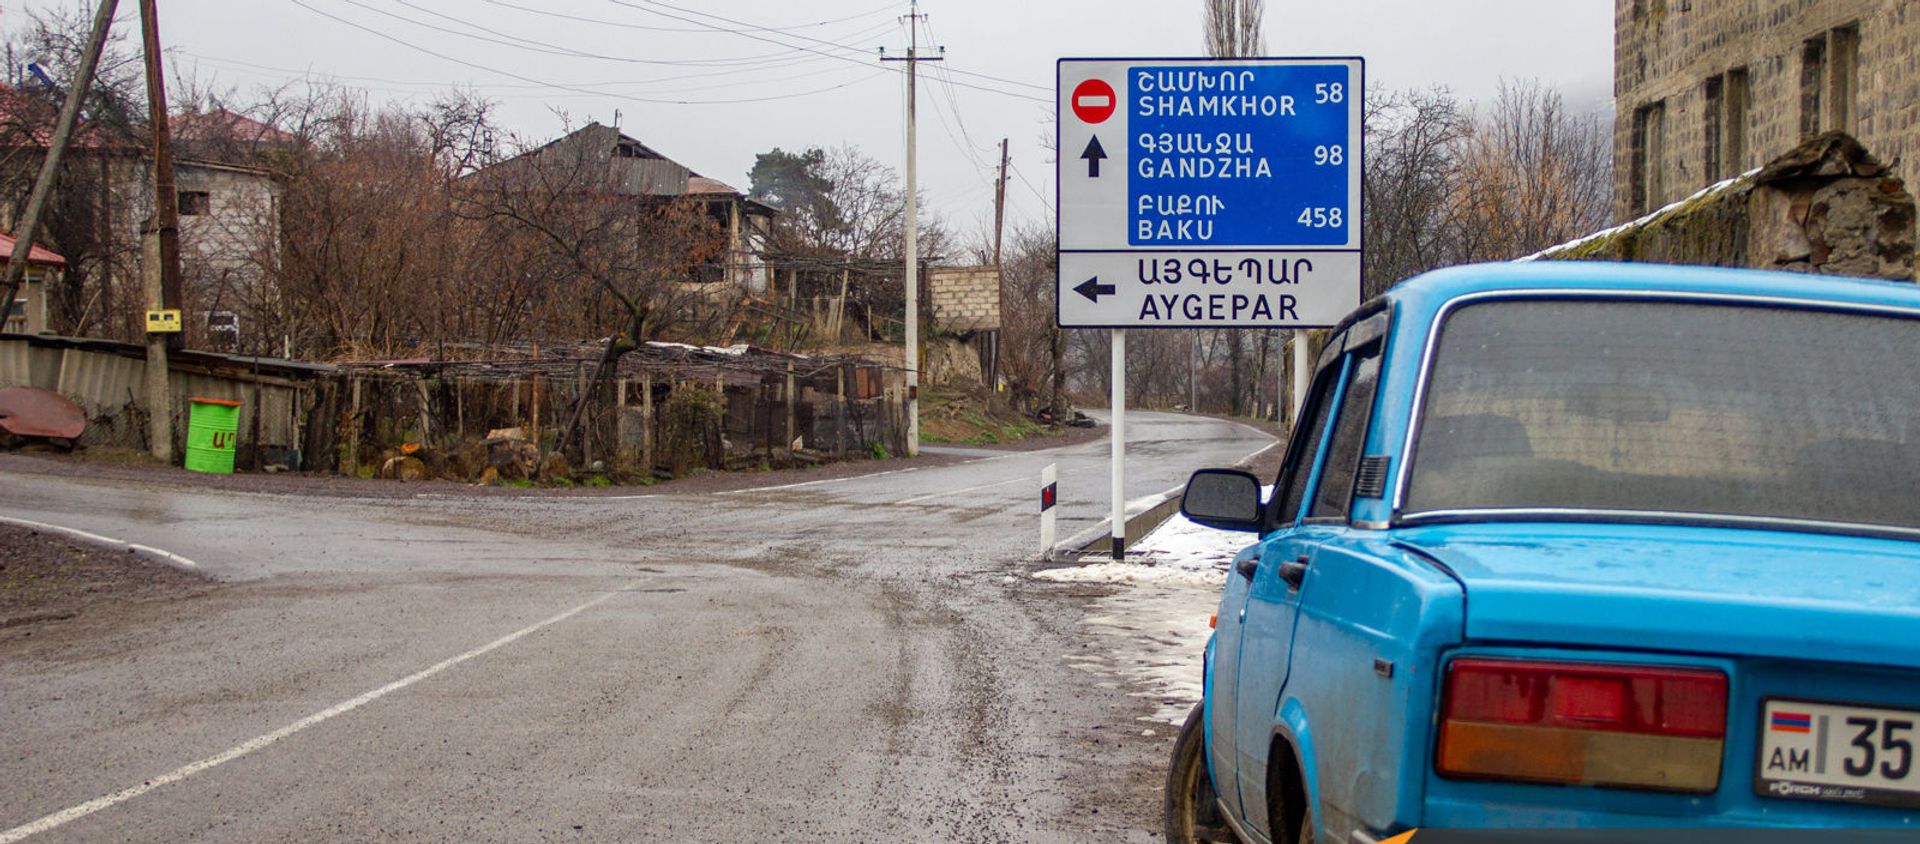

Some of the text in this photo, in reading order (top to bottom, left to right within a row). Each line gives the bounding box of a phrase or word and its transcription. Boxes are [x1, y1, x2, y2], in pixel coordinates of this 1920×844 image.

[1138, 71, 1255, 92] ՇԱՄԽՈՐ
[1315, 82, 1343, 104] 58
[1138, 95, 1297, 117] SHAMKHOR
[1138, 132, 1254, 154] ԳՅԱՆՋԱ
[1314, 145, 1343, 166] 98
[1138, 157, 1272, 178] GANDZHA
[1138, 194, 1225, 216] ԲԱՔՈՒ
[1297, 207, 1343, 228] 458
[1138, 219, 1214, 240] BAKU
[1138, 258, 1313, 285] ԱՅԳԵՊԱՐ
[1138, 293, 1299, 320] AYGEPAR
[1767, 746, 1809, 772] AM
[1843, 716, 1913, 780] 35
